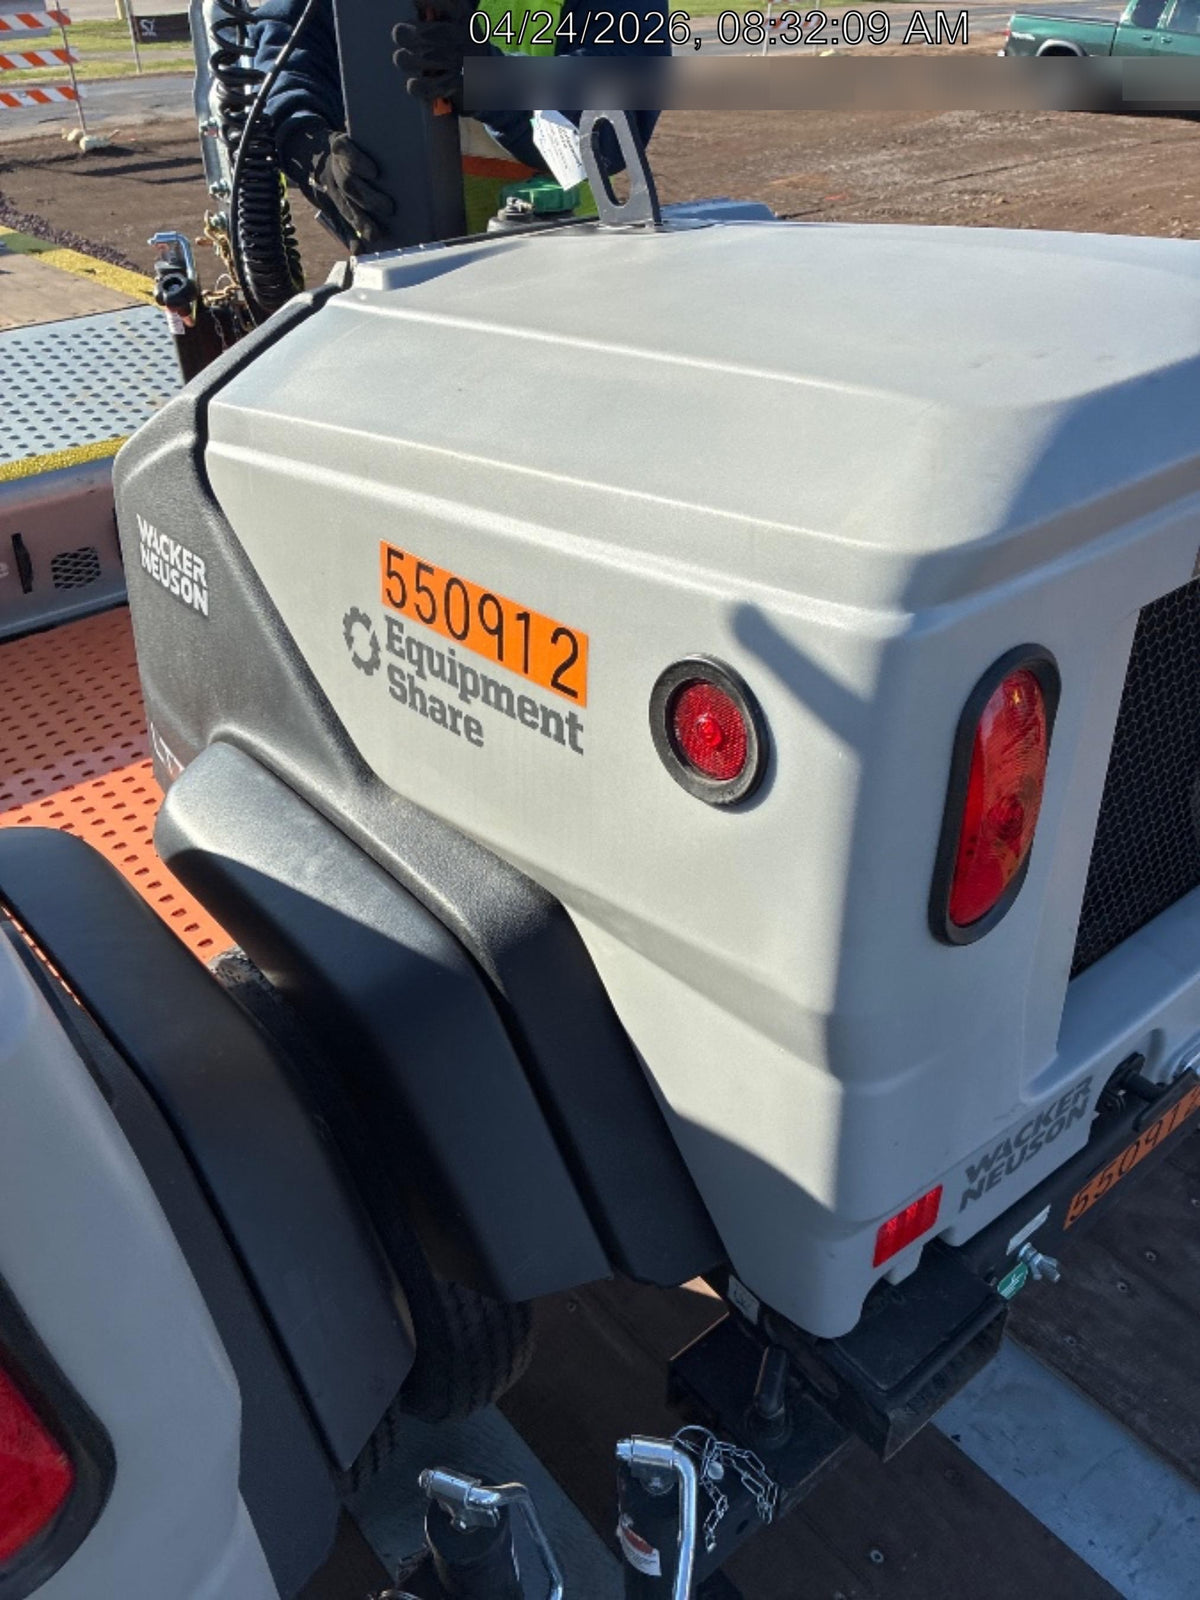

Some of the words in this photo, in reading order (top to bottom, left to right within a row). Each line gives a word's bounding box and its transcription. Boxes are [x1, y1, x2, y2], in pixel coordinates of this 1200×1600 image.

[136, 514, 207, 587] WACKER
[139, 541, 209, 617] NEUSON
[385, 546, 579, 699] 550912
[384, 614, 585, 756] Equipment
[386, 662, 485, 748] Share
[958, 1095, 1090, 1214] NEUSON
[964, 1075, 1094, 1184] WACKER
